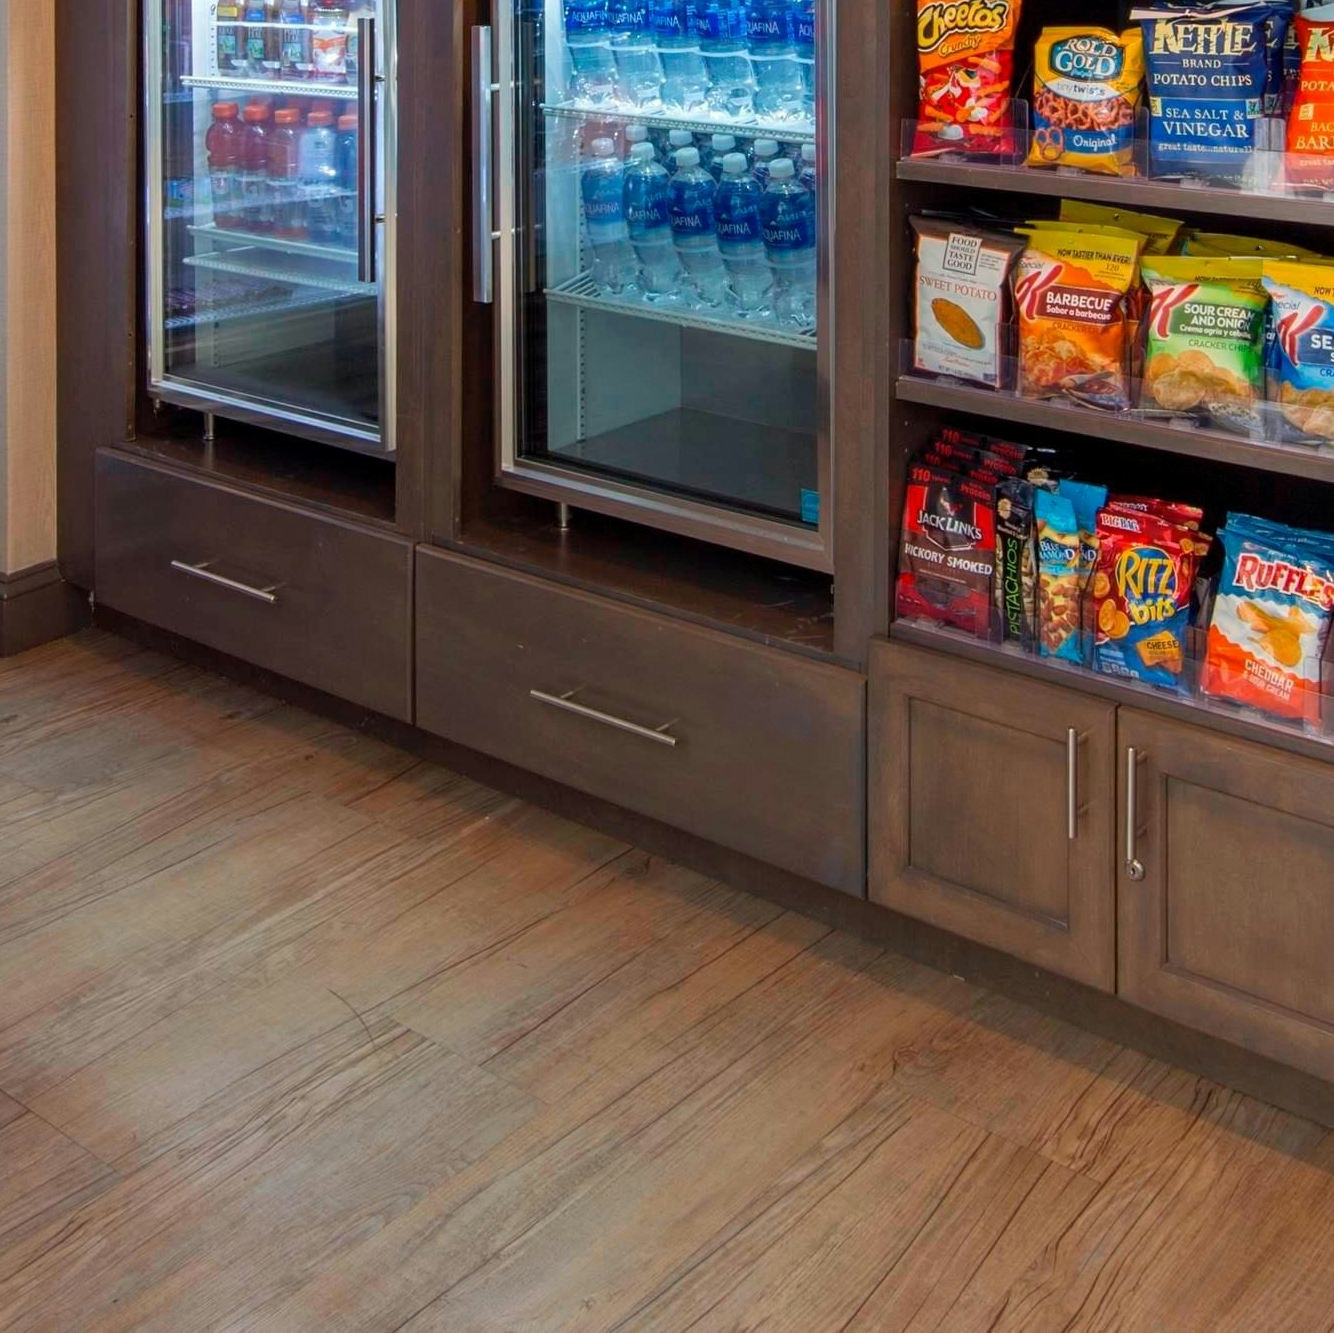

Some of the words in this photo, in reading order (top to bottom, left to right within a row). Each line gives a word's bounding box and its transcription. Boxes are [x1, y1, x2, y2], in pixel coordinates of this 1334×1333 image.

[1149, 17, 1257, 57] KETTLE
[1064, 37, 1117, 57] ROLD
[1055, 52, 1116, 76] GOLD
[1182, 59, 1222, 69] BRAND
[1153, 73, 1207, 86] POTATO
[1211, 74, 1253, 87] CHIPS
[1166, 107, 1189, 120] SEA
[1194, 108, 1229, 121] SALT
[1233, 110, 1244, 120] &
[1163, 121, 1250, 139] VINEGAR
[1072, 132, 1117, 148] Original
[1158, 142, 1181, 153] great
[951, 236, 978, 248] FOOD
[946, 259, 973, 271] GOOD
[948, 251, 975, 262] TASTE
[919, 275, 953, 293] SWEET
[955, 284, 998, 302] POTATO
[1314, 286, 1332, 296] NOW
[1046, 291, 1113, 311] BARBECUE
[1046, 303, 1069, 316] Sabor
[1075, 308, 1112, 321] barbecue
[1183, 303, 1216, 317] SOUR
[1217, 306, 1255, 321] CREAM
[1179, 324, 1204, 336] Crema
[1204, 327, 1222, 338] agria
[1190, 315, 1216, 327] AND
[1217, 316, 1251, 332] ONION
[1188, 338, 1228, 351] CRACKER
[912, 466, 932, 483] 110
[917, 509, 946, 532] JACK
[904, 542, 945, 565] HICKORY
[946, 555, 993, 577] SMOKED
[1118, 550, 1175, 599] RITZ
[1006, 539, 1022, 635] PISTACHIOS
[1129, 598, 1177, 626] bits
[1146, 639, 1179, 650] CHEESE
[1244, 659, 1295, 692] CHEDDAR
